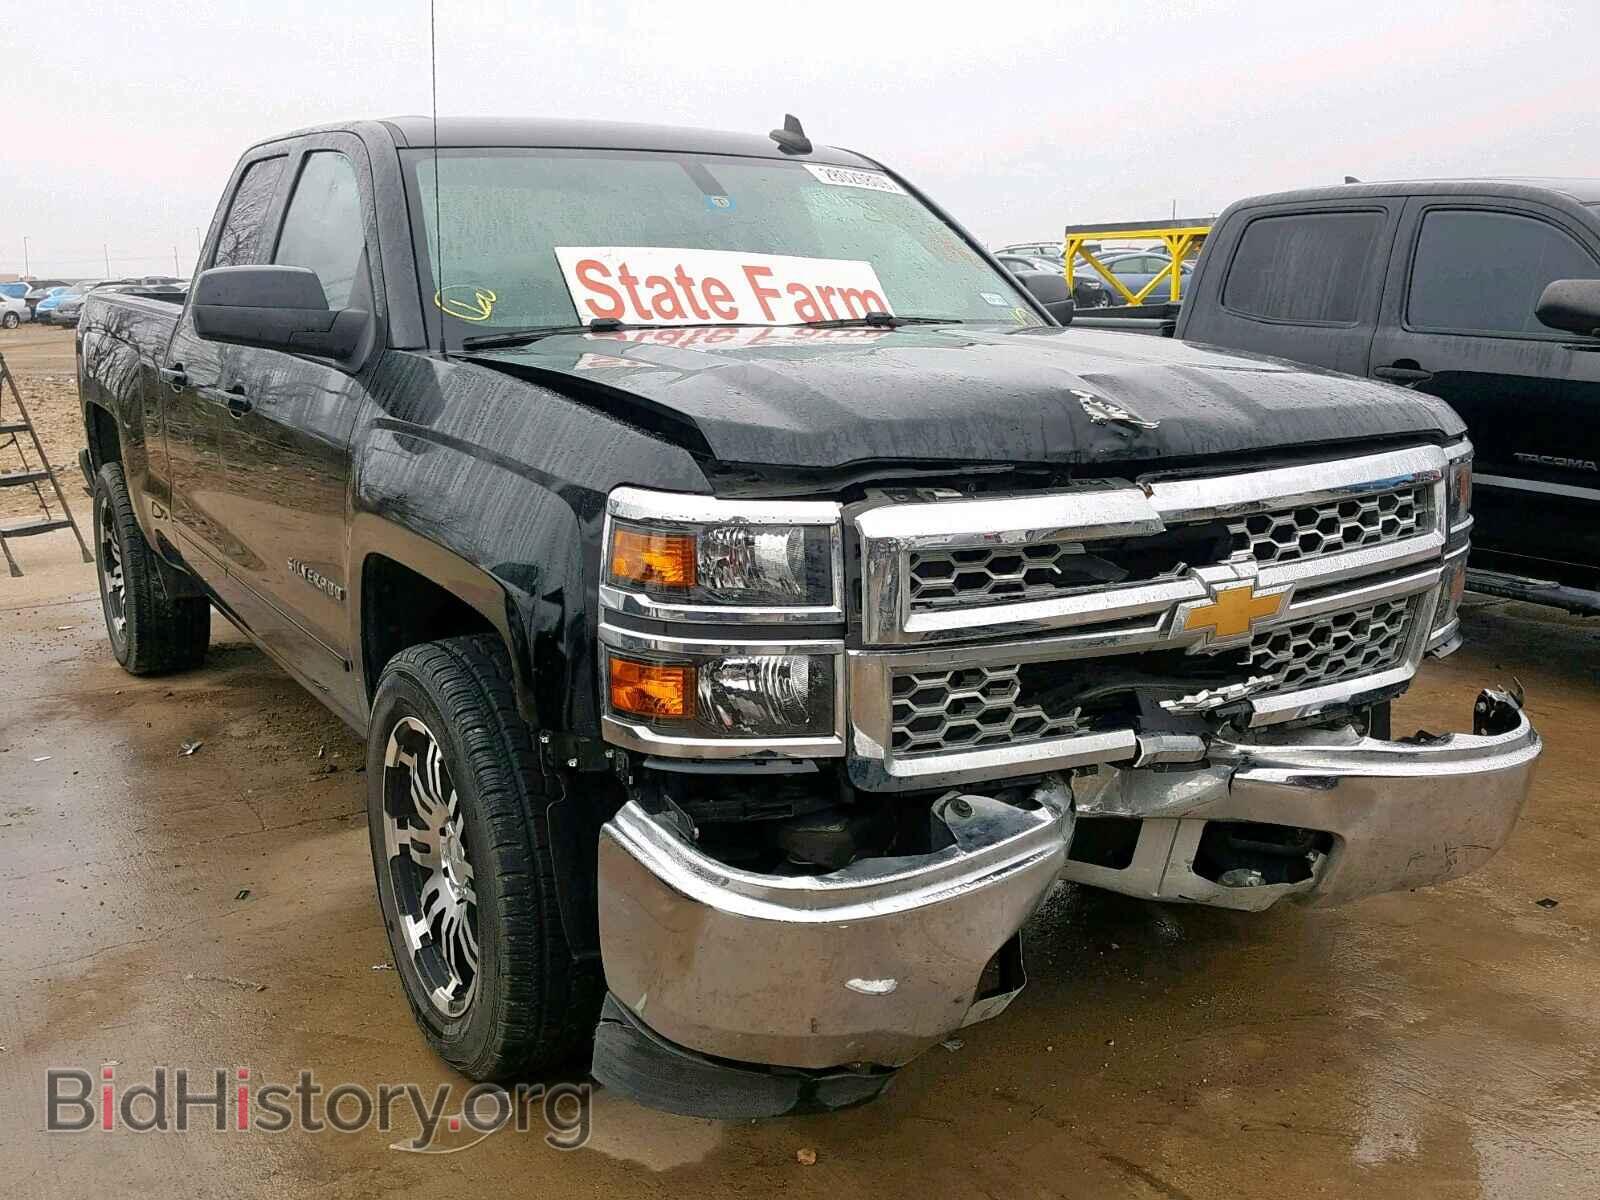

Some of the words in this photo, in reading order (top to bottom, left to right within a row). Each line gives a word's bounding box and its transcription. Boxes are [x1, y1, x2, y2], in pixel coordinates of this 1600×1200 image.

[575, 258, 739, 321] State
[741, 264, 888, 322] Farm
[1513, 452, 1598, 471] TACOMA
